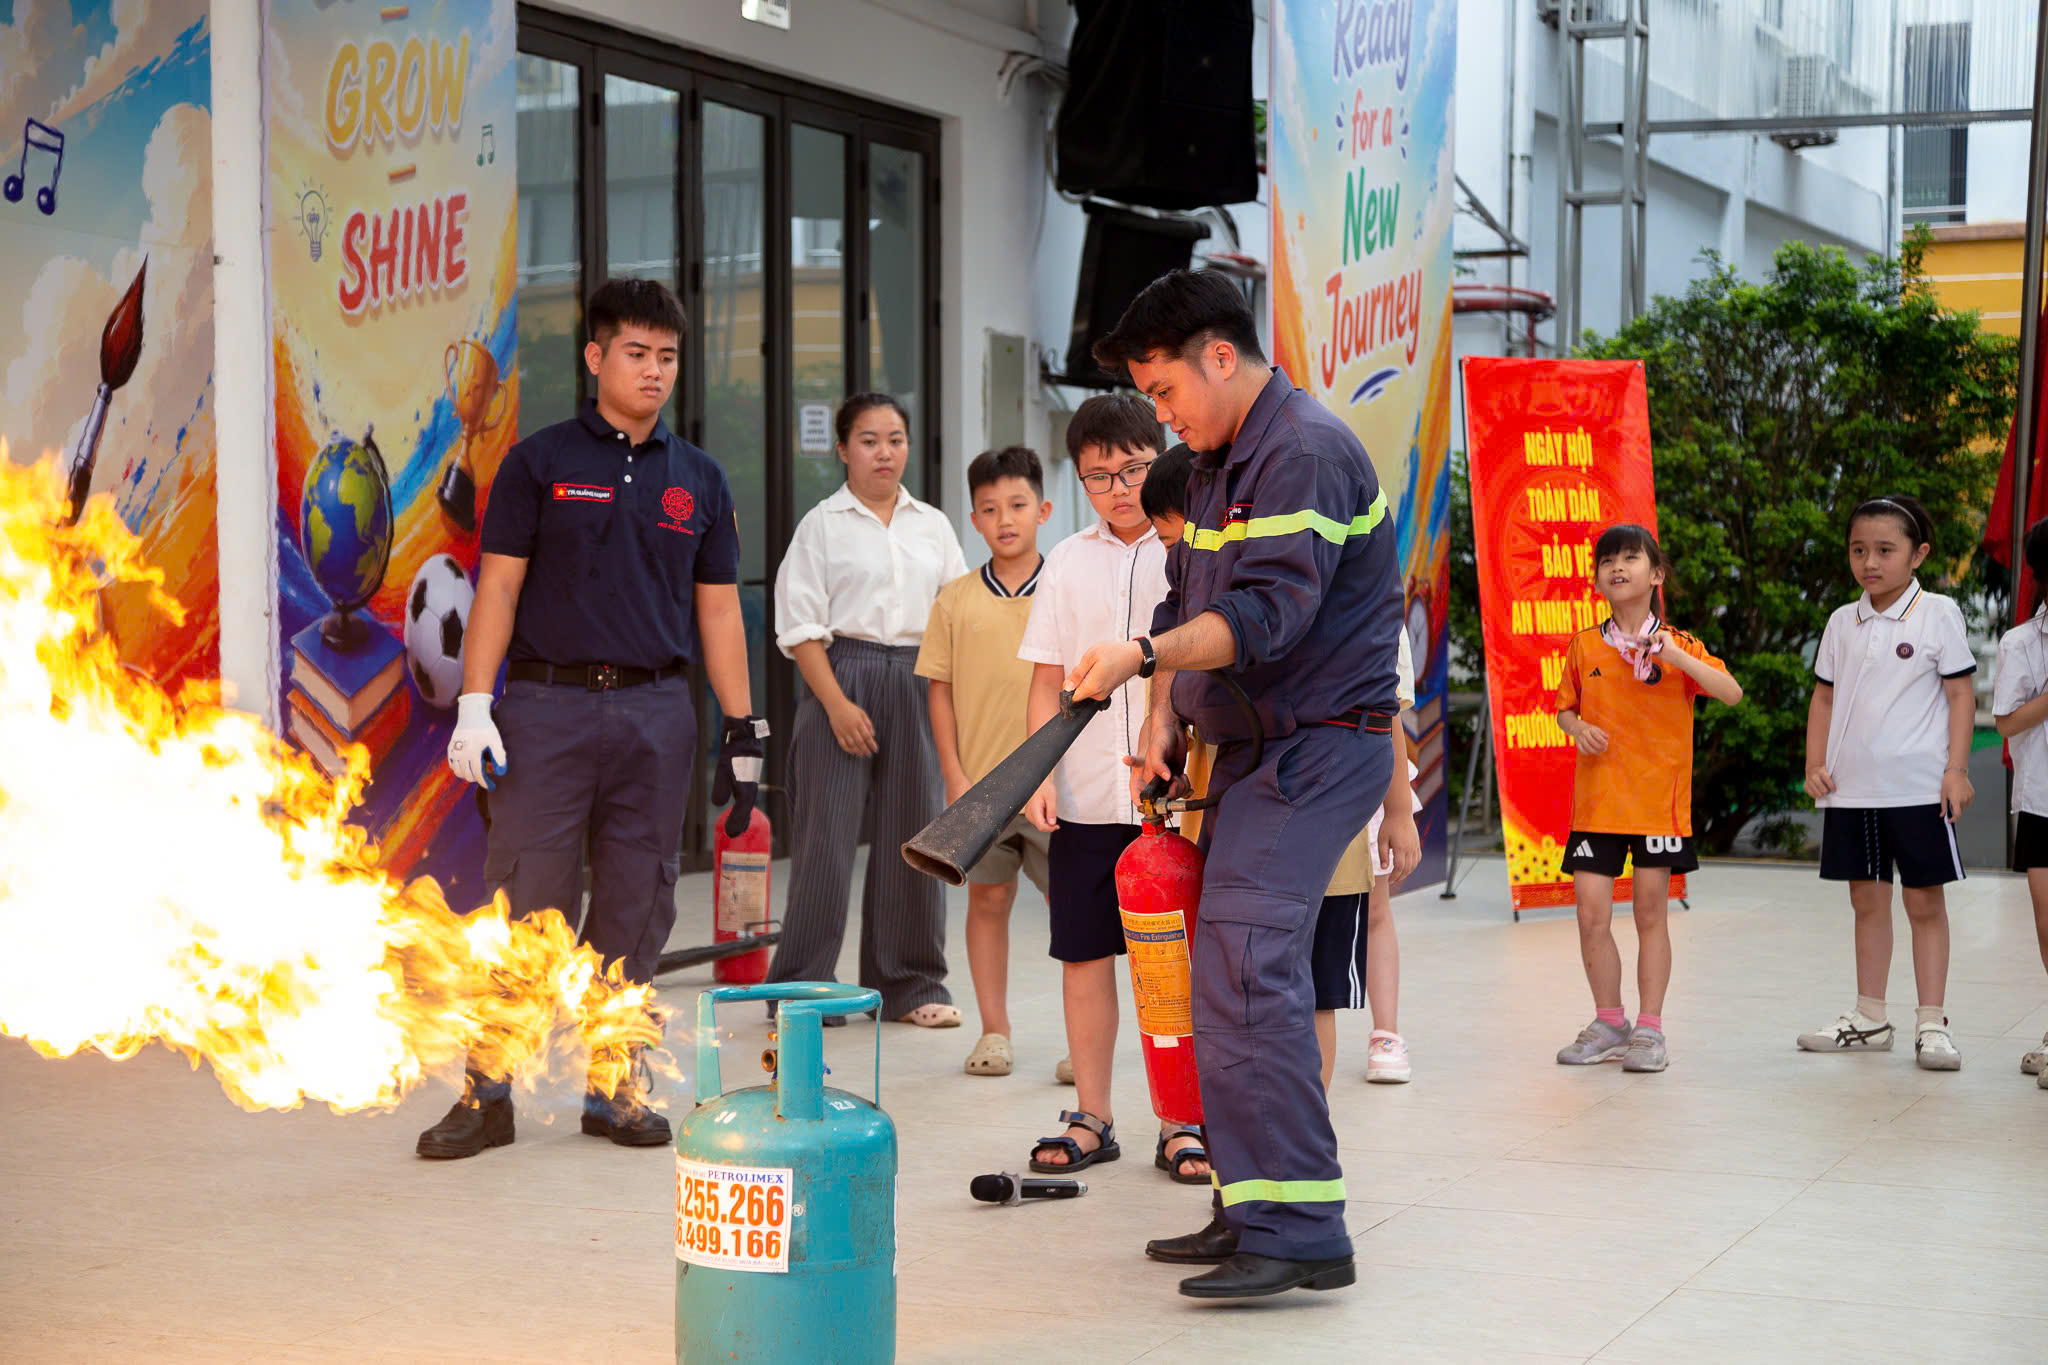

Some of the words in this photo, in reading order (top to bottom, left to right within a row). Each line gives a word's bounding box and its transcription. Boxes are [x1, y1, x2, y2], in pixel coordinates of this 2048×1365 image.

[1333, 0, 1412, 91] Ready
[326, 32, 470, 143] GROW
[1352, 87, 1378, 160] for
[1382, 106, 1393, 147] a
[1342, 165, 1400, 267] New
[339, 192, 468, 311] SHINE
[1321, 268, 1422, 389] Journey
[1523, 425, 1563, 466] NGÀY
[1566, 425, 1593, 473] HỘI
[1526, 481, 1567, 522] TOÀN
[1568, 481, 1600, 522] DÂN
[1541, 533, 1573, 578] BẢO
[1574, 537, 1595, 584] VỆ
[1512, 600, 1533, 635] AN
[1535, 600, 1573, 635] NINH
[1140, 933, 1151, 941] Fire
[708, 1169, 784, 1184] PETROLIMEX
[675, 1217, 781, 1259] 6.499.166
